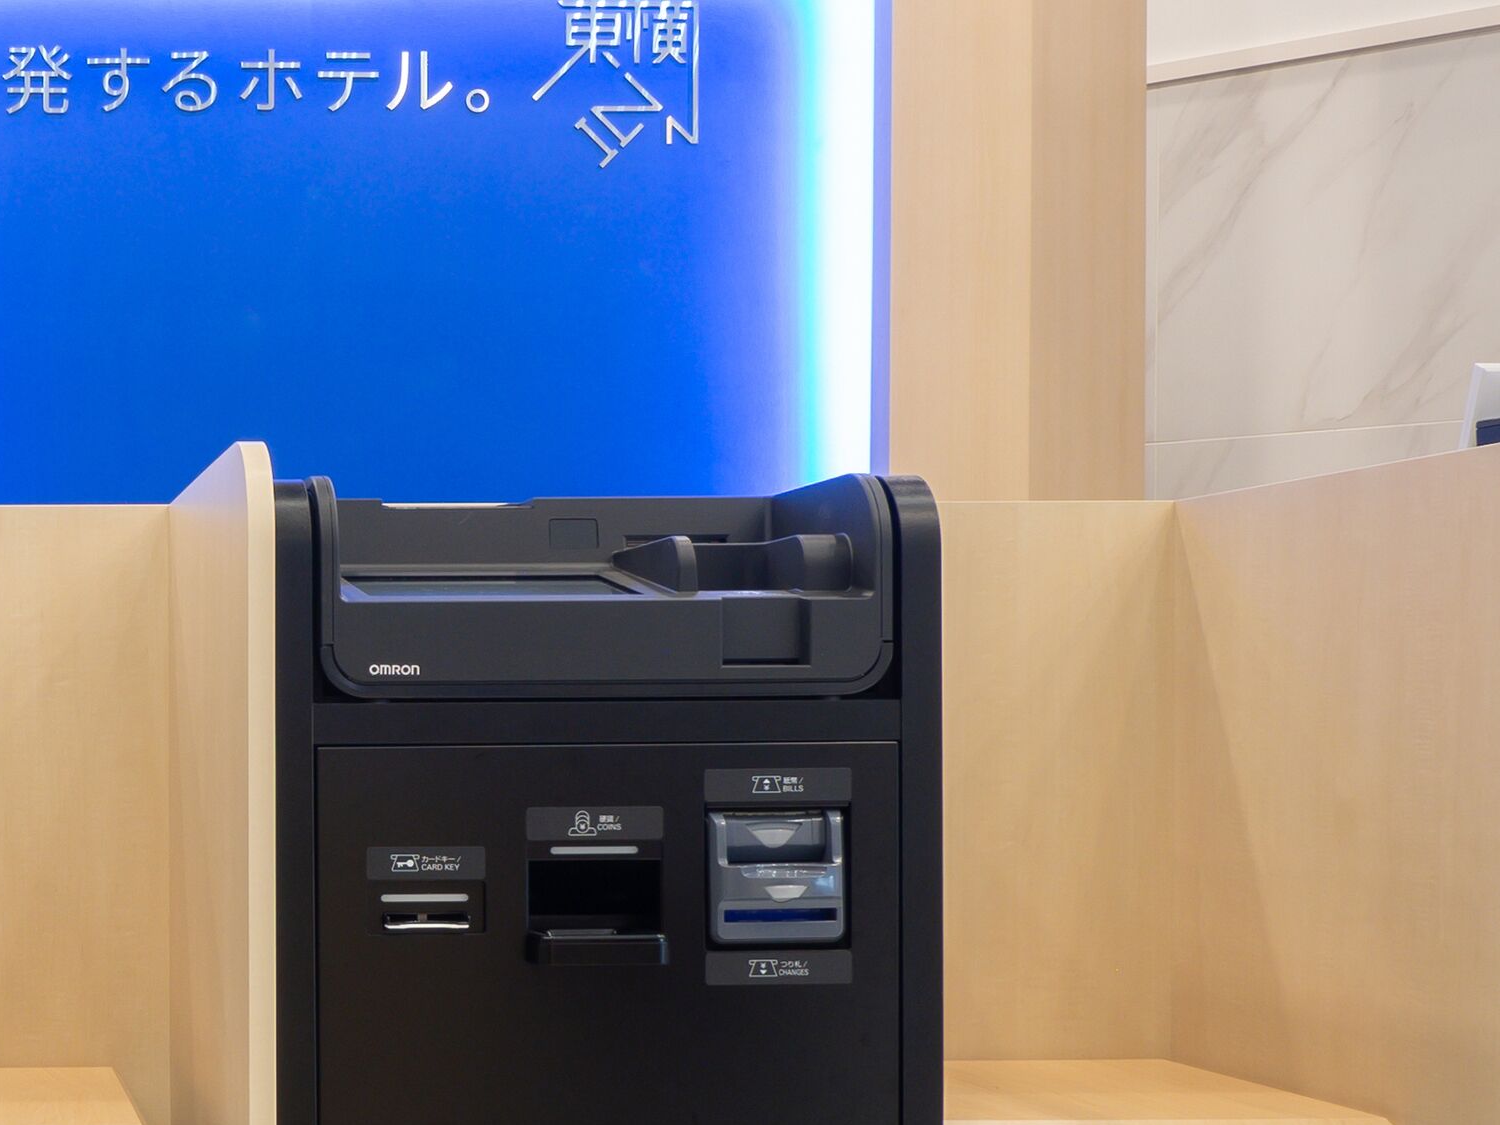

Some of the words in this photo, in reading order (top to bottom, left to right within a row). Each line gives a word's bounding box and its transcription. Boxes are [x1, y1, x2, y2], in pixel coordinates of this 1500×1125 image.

[782, 785, 804, 793] BILLS
[596, 823, 622, 832] COINS
[421, 863, 443, 872] CARD
[443, 863, 460, 872] KEY
[778, 969, 810, 978] CHANGES
